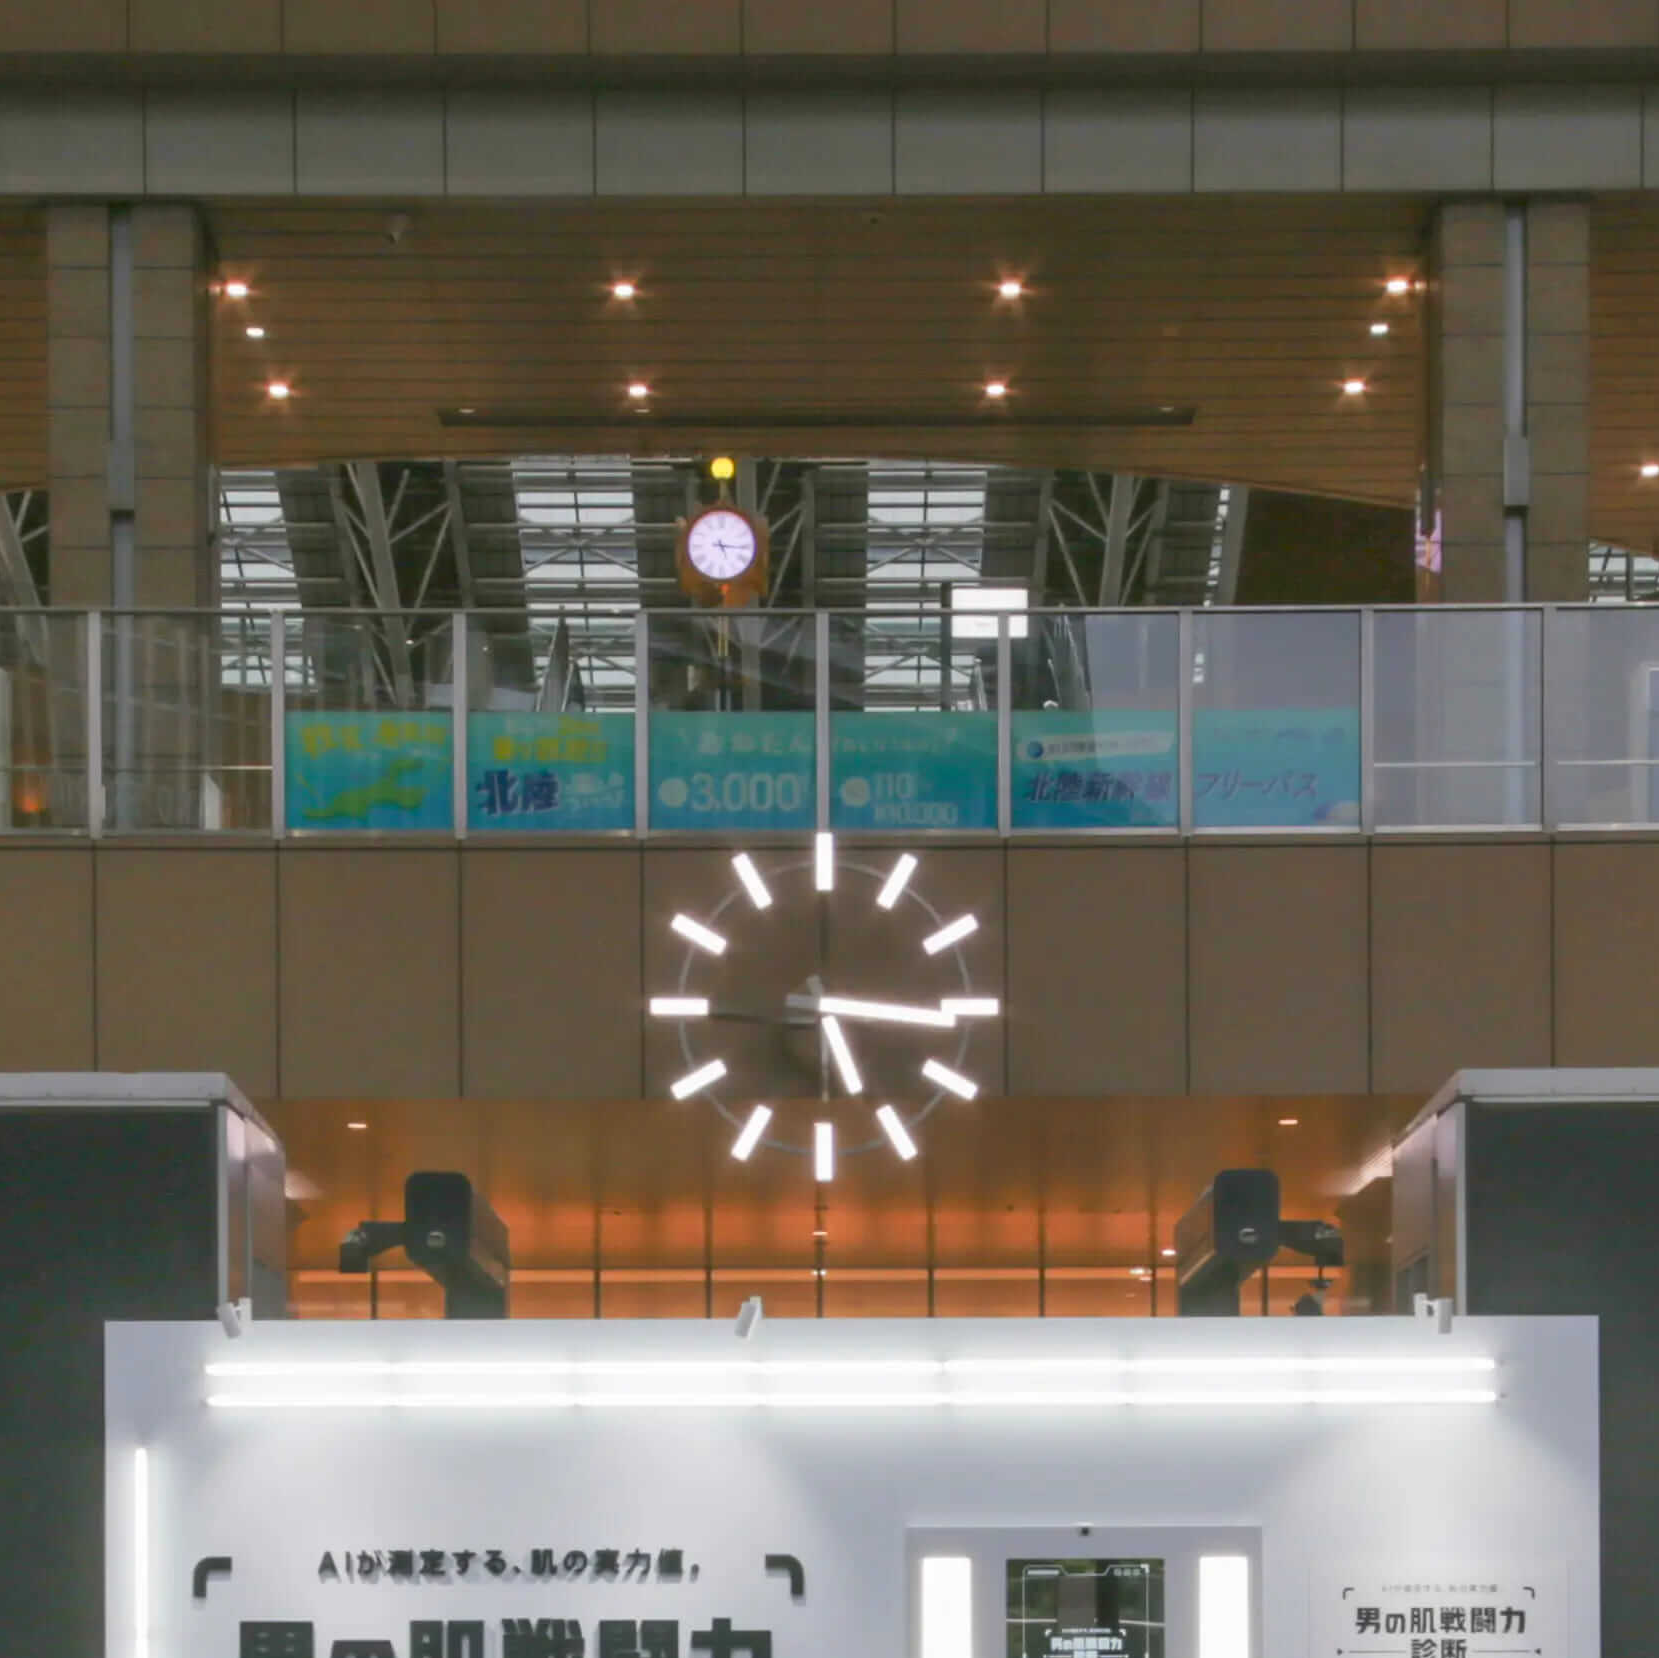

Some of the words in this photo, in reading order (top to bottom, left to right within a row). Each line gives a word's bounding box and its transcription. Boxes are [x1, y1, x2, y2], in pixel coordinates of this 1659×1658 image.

[1355, 1607, 1526, 1634] 男の肌戦闘力
